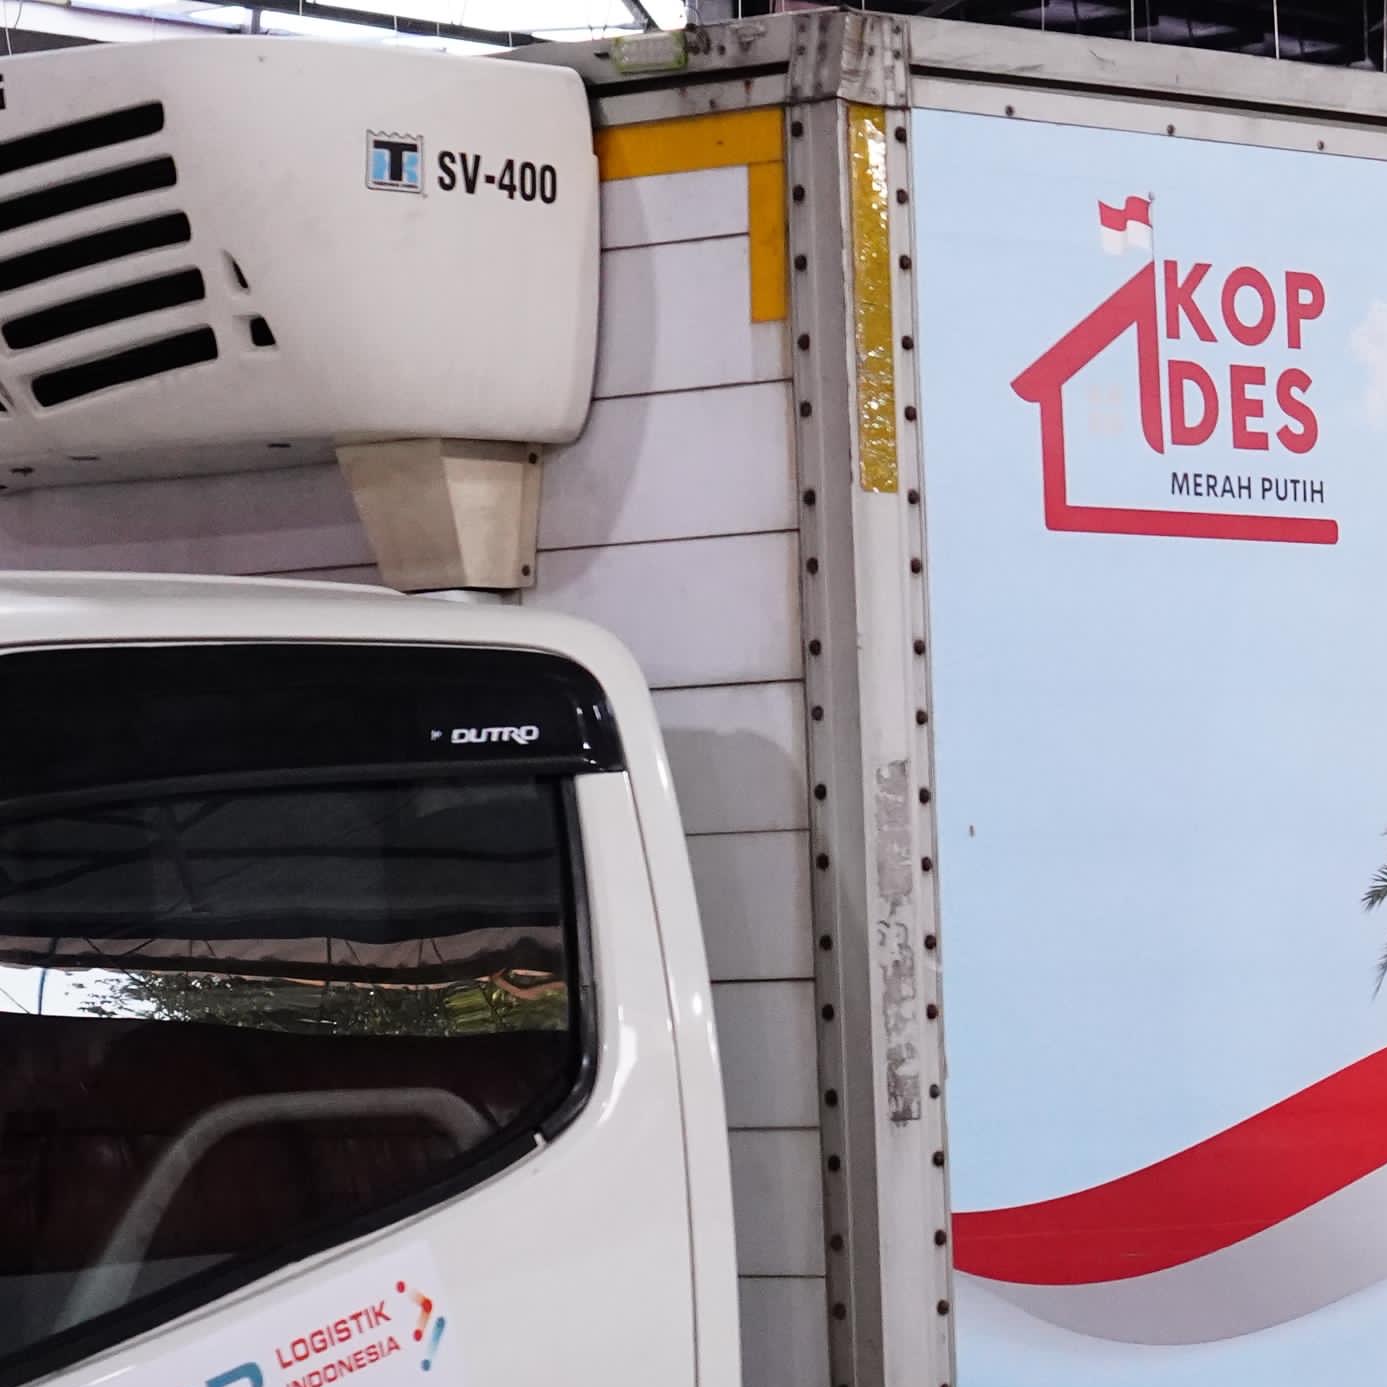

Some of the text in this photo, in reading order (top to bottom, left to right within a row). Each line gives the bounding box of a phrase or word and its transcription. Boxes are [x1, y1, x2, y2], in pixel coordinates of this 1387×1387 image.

[437, 150, 558, 204] SV-400
[1163, 258, 1326, 350] KOP
[1167, 359, 1319, 455] DES
[1170, 471, 1325, 504] MERAH PUTIH
[451, 725, 540, 745] DUTRO
[274, 1300, 392, 1370] LOGISTIK
